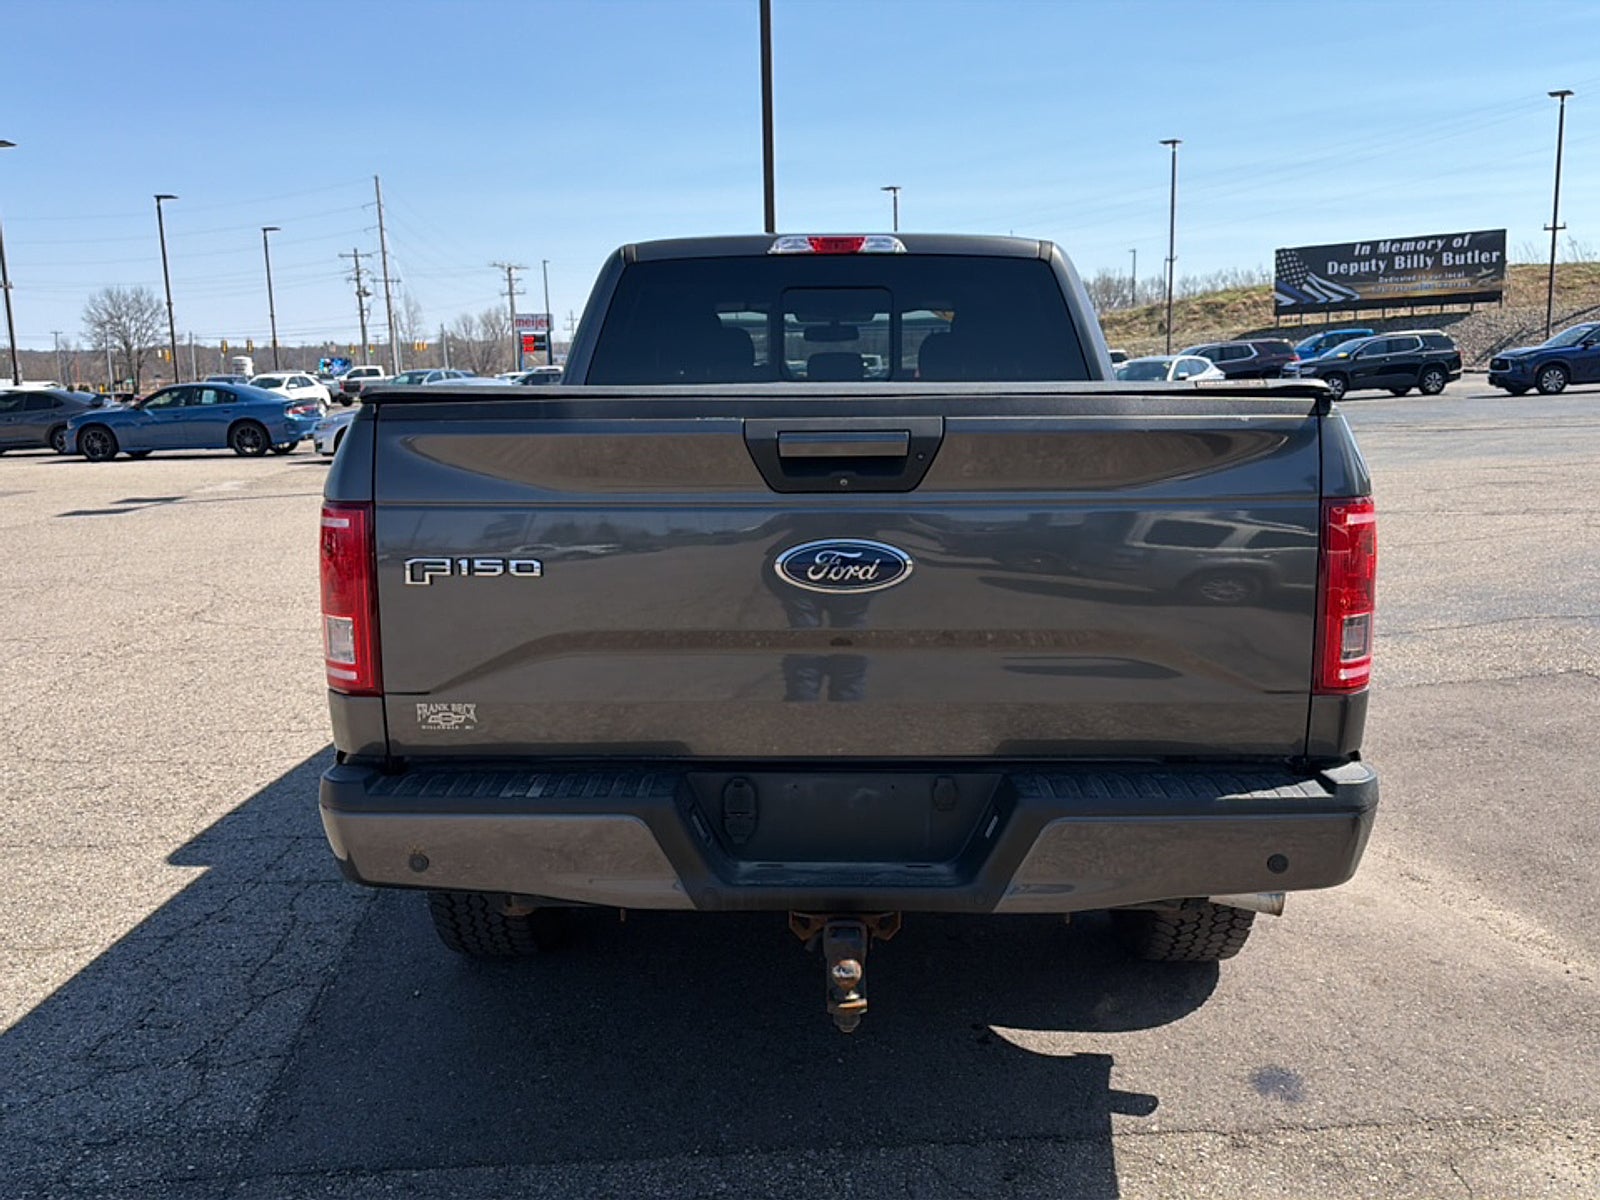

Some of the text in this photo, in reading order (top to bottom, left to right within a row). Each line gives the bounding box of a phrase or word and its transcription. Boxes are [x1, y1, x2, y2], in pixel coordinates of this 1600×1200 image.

[1353, 234, 1473, 257] In Memory of
[1326, 249, 1501, 277] Deputy Billy Butler
[807, 549, 881, 581] Ford
[416, 703, 450, 723] FRANK
